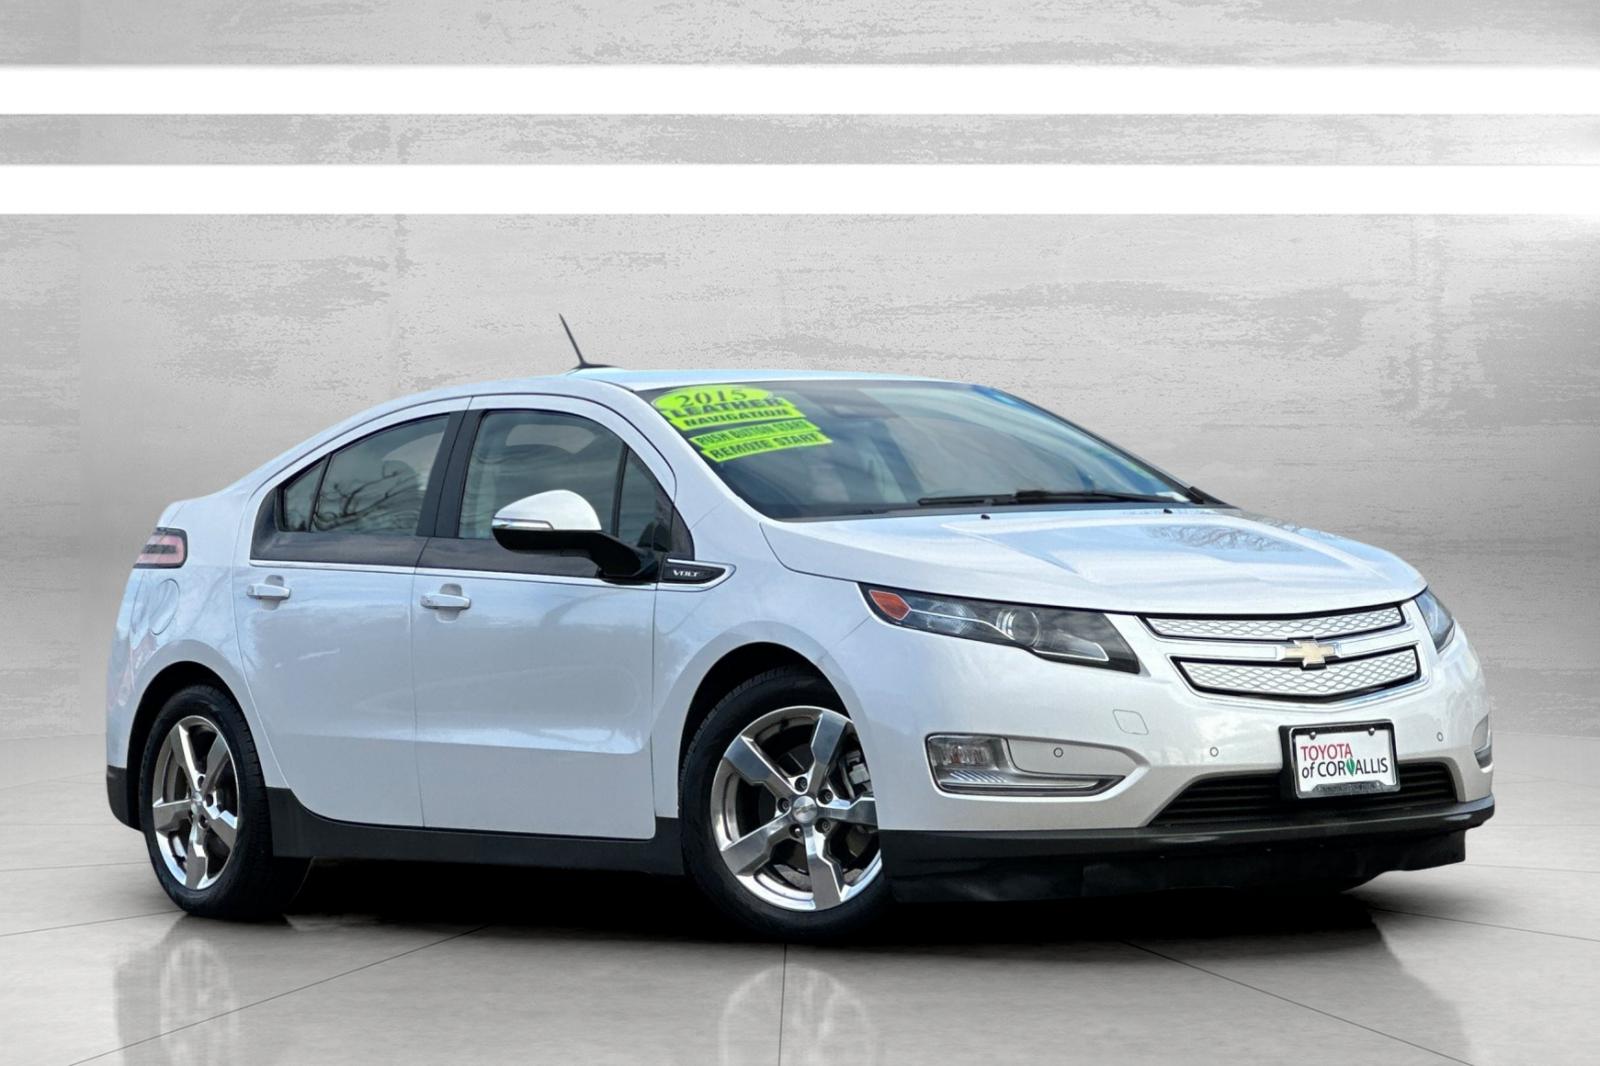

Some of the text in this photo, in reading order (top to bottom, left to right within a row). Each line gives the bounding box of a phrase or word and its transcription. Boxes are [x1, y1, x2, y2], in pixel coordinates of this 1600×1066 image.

[671, 398, 785, 417] LEATHER
[674, 390, 747, 408] 2015
[685, 408, 788, 426] NAVIGATION
[696, 431, 730, 444] PUSH
[711, 433, 819, 458] REMOTE START
[673, 569, 699, 577] VOLT
[1301, 743, 1353, 761] TOYOTA
[1302, 757, 1389, 778] of CORVALLIS
